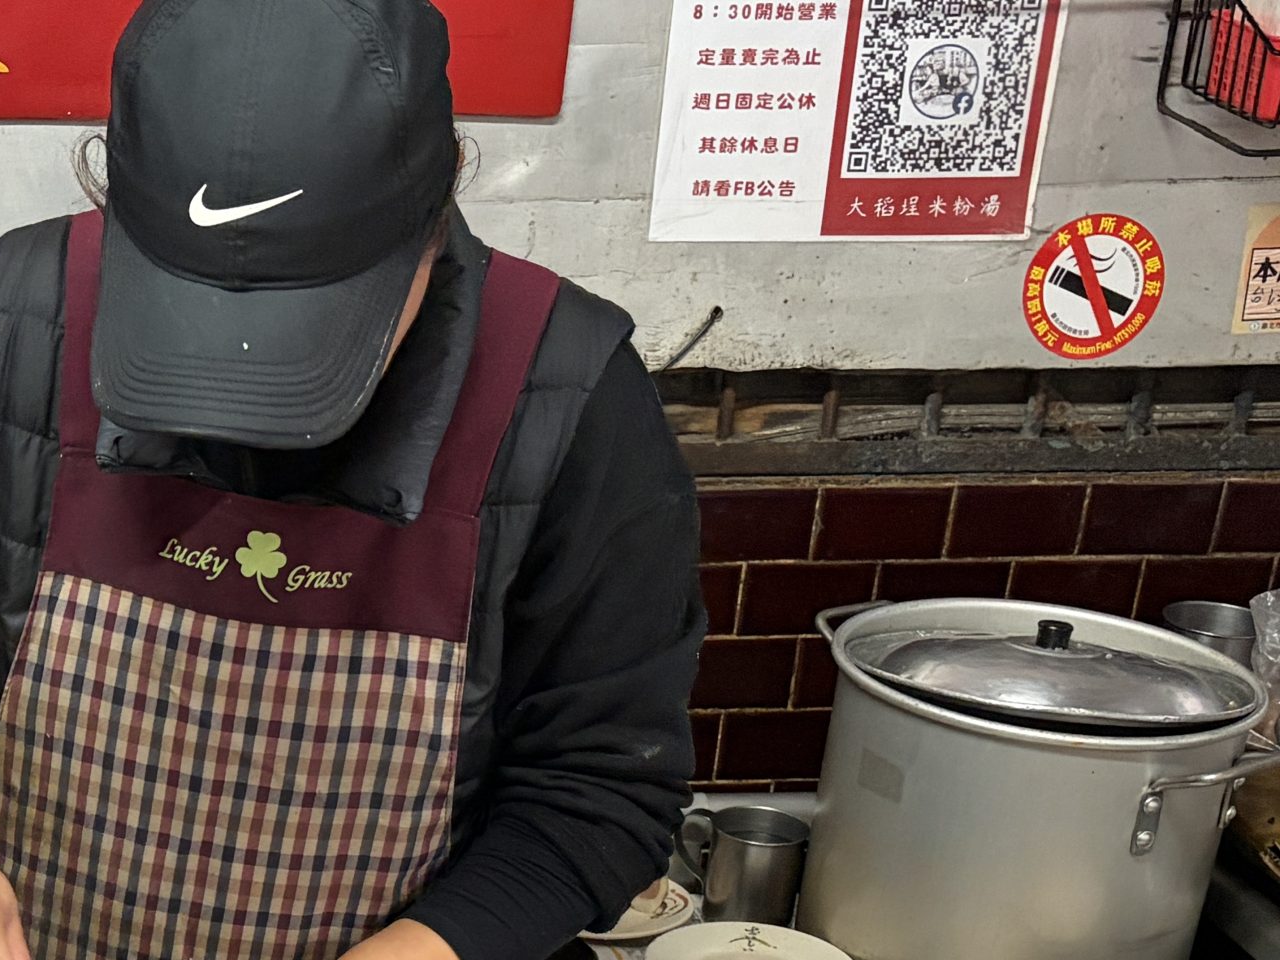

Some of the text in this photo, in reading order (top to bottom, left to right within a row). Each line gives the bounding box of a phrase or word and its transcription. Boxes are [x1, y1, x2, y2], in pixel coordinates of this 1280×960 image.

[696, 48, 822, 66] 定量賣完為止
[692, 92, 817, 110] 週日固定公休
[698, 136, 799, 154] 其餘休息日
[692, 179, 796, 197] 請看FB公告
[846, 194, 1001, 218] 大稻埕米粉湯
[158, 538, 353, 592] Lucky Grass
